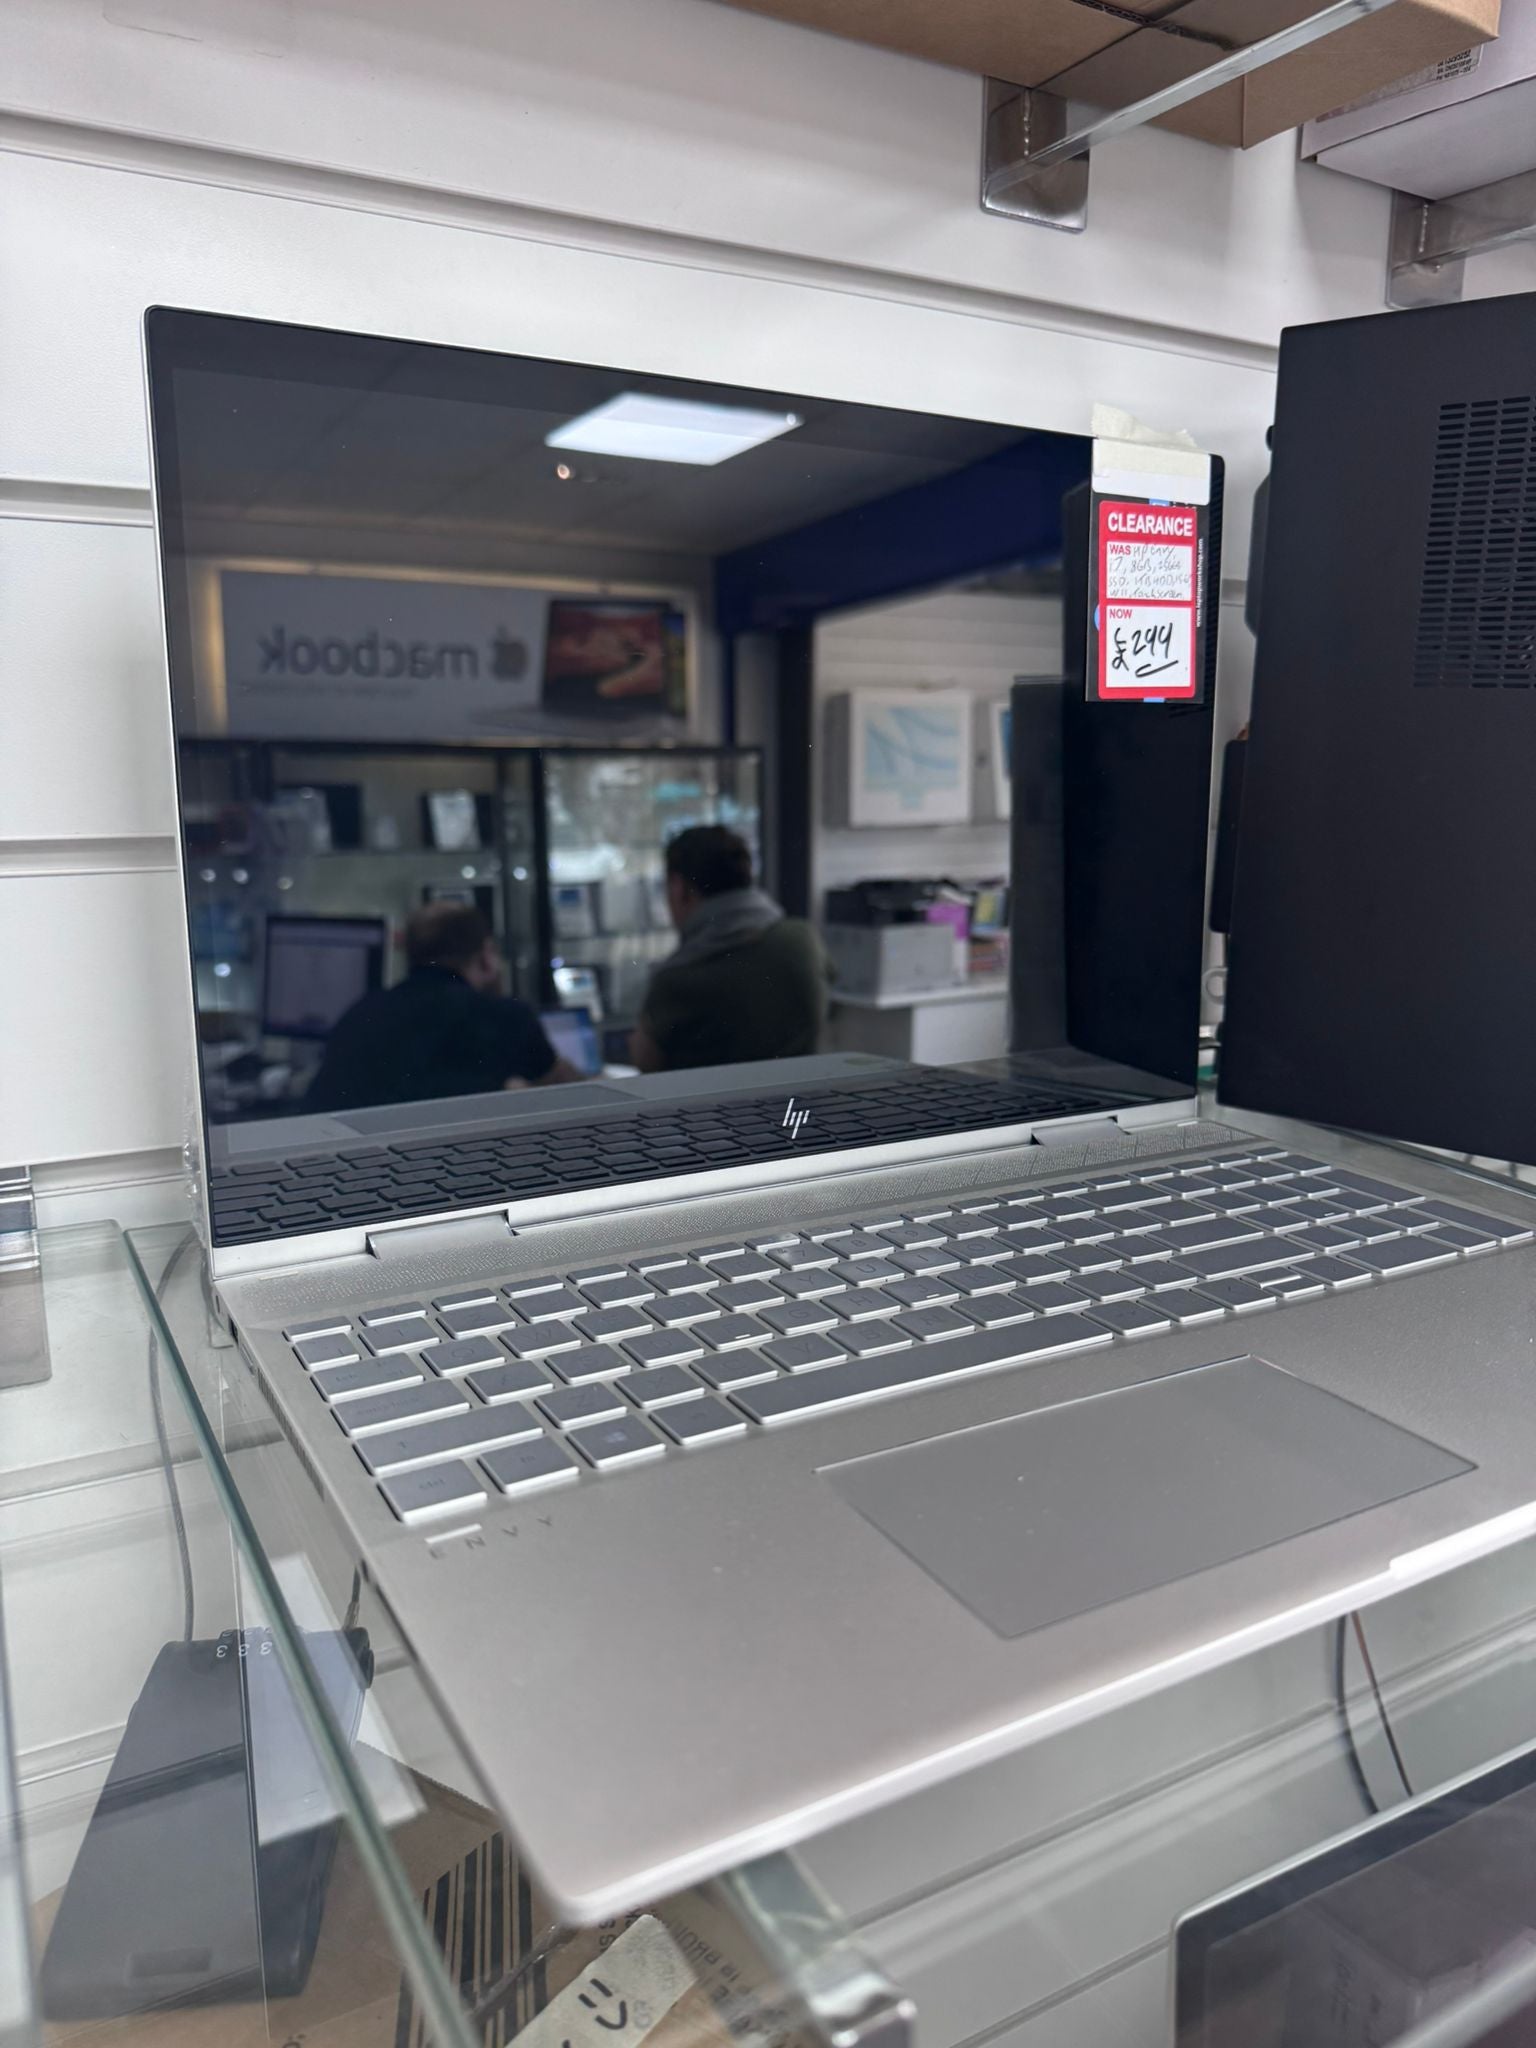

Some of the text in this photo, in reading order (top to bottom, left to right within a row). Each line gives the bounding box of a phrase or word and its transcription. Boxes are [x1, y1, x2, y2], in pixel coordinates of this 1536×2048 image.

[1108, 512, 1193, 537] CLEARANCE
[1109, 544, 1131, 555] WAS
[1109, 608, 1133, 619] NOW
